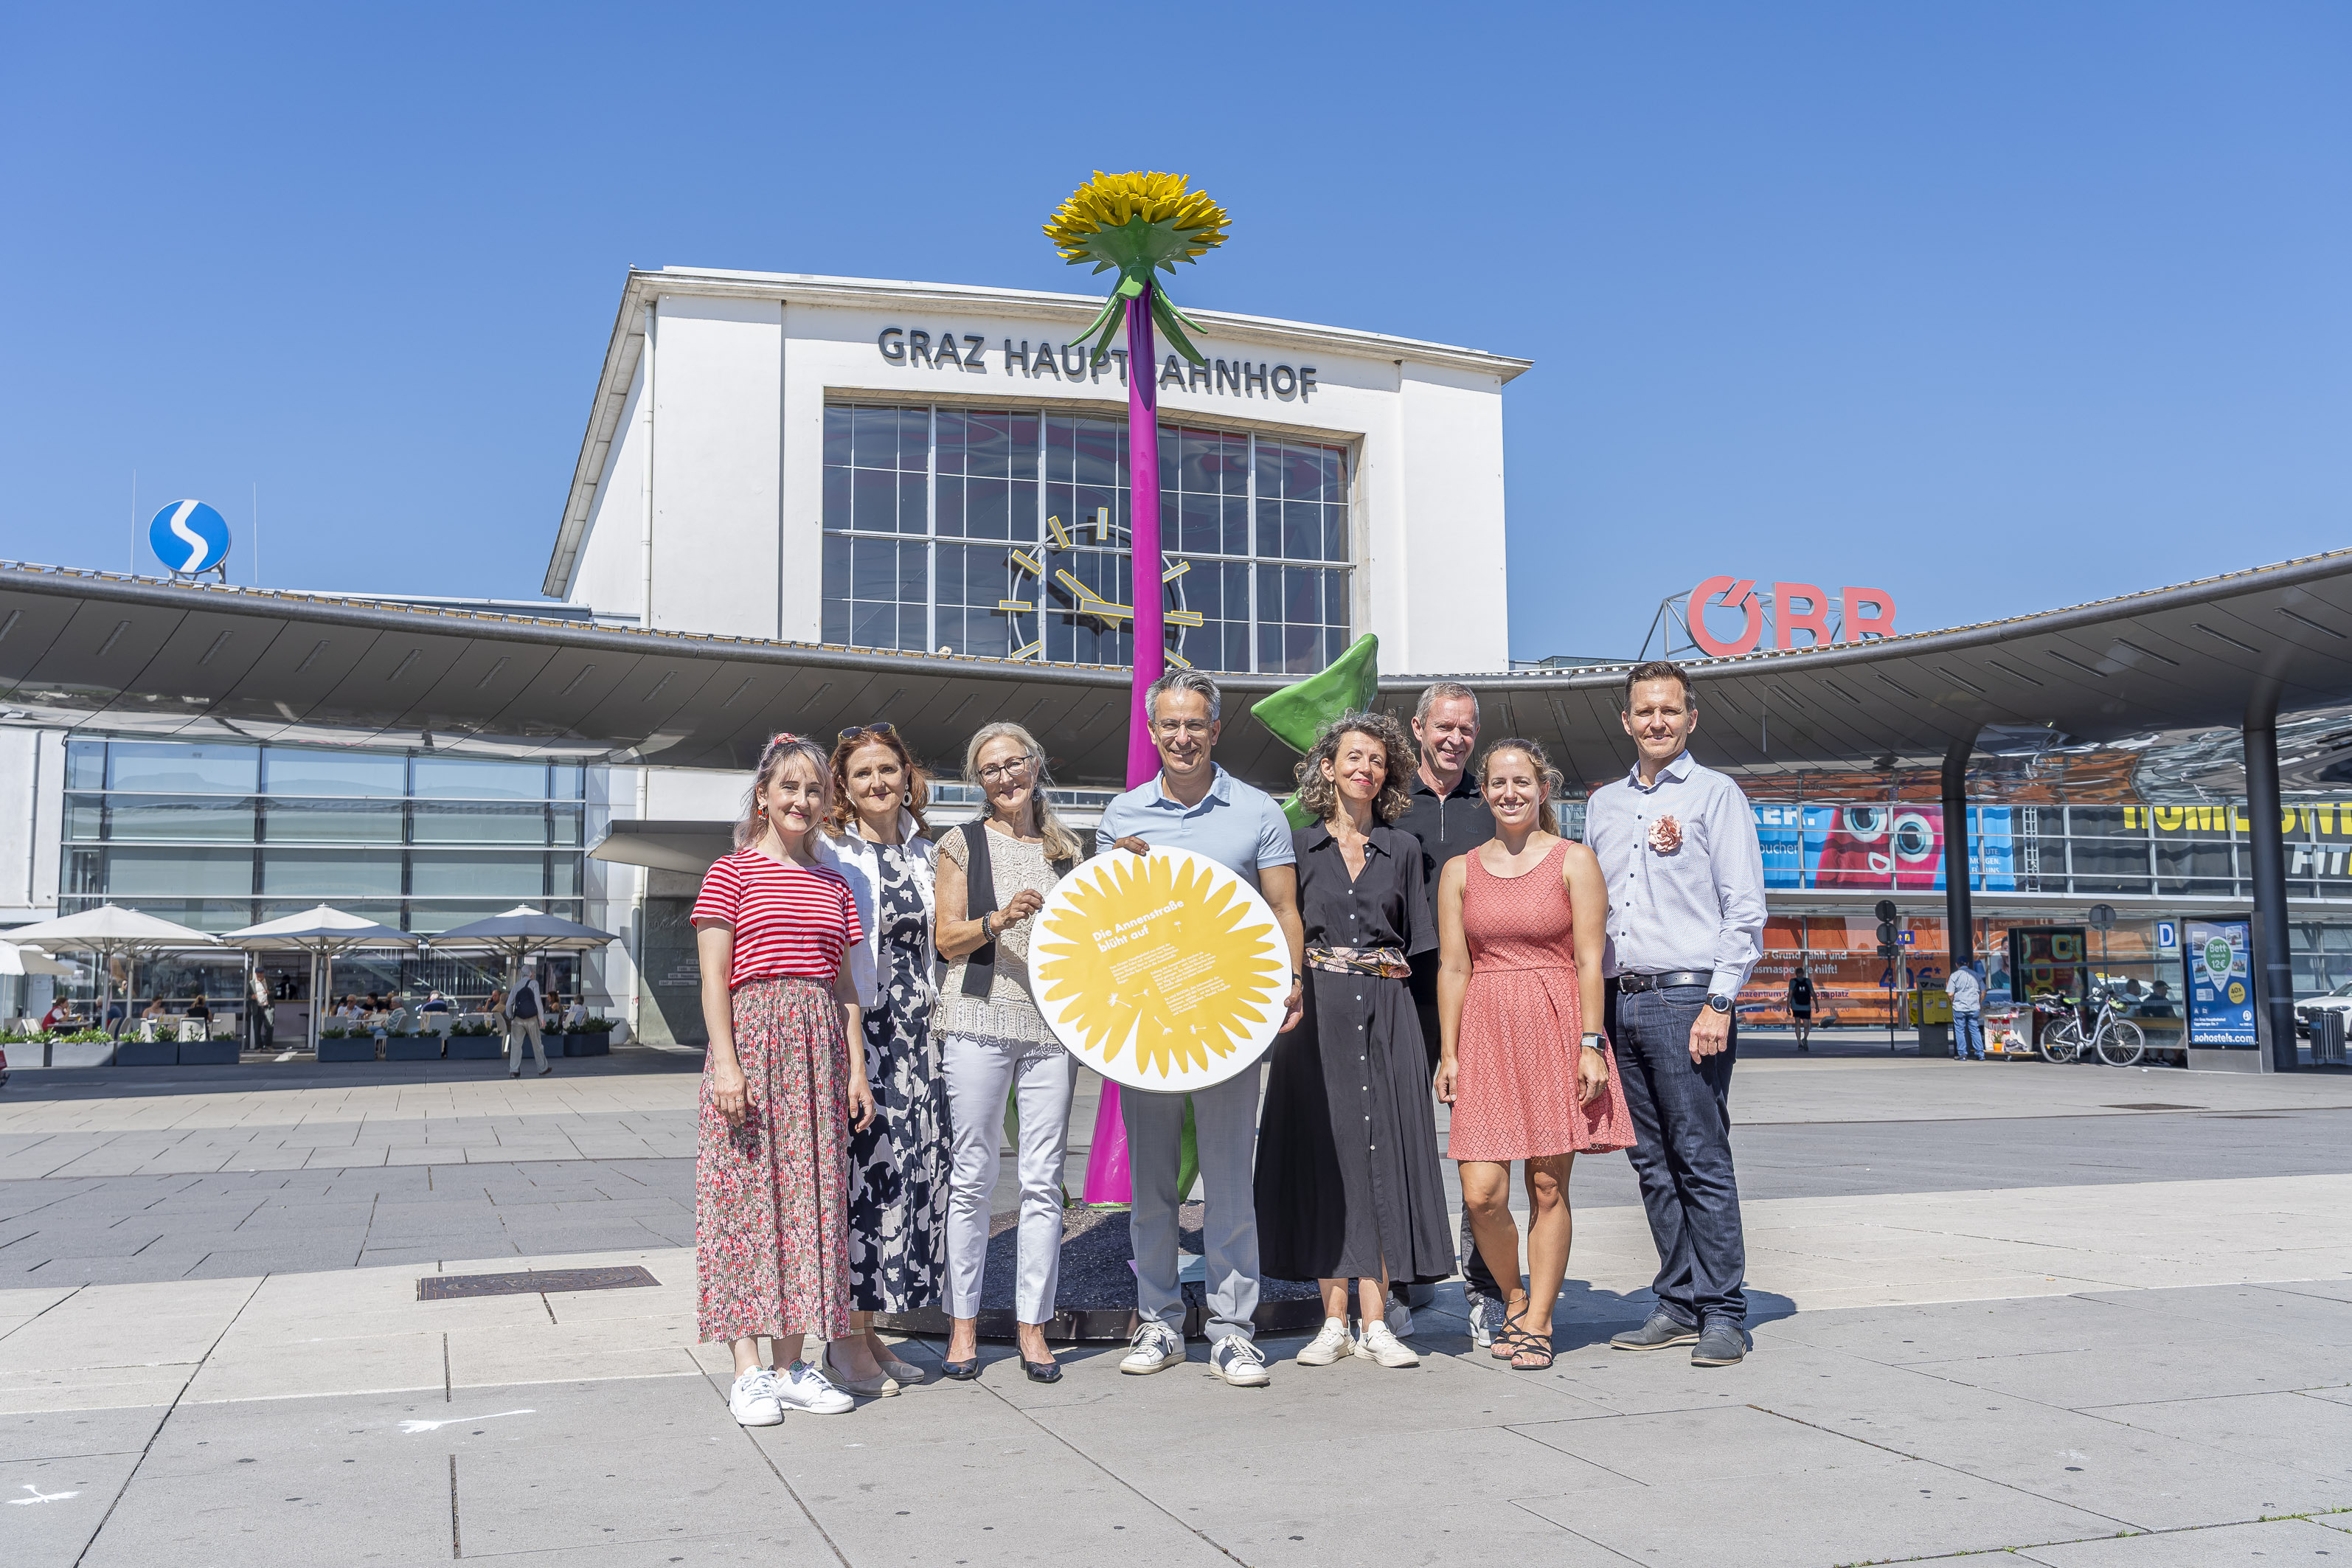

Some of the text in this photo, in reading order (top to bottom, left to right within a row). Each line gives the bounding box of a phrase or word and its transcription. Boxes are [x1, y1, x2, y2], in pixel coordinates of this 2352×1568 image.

[878, 327, 1317, 397] GRAZ HAUPTAHNHOF
[1685, 575, 1897, 656] ÖBB
[1092, 901, 1184, 942] Die Annenstraße
[1097, 925, 1149, 953] blüht auf
[2160, 924, 2174, 947] D
[2210, 944, 2227, 953] Bett
[1772, 951, 1801, 960] Grund
[1808, 951, 1827, 960] ählt
[1829, 951, 1848, 960] und
[1815, 964, 1838, 974] hilft!
[2212, 960, 2227, 968] 12€
[1818, 991, 1849, 999] opaplatz
[2194, 1033, 2254, 1043] aohostels.com
